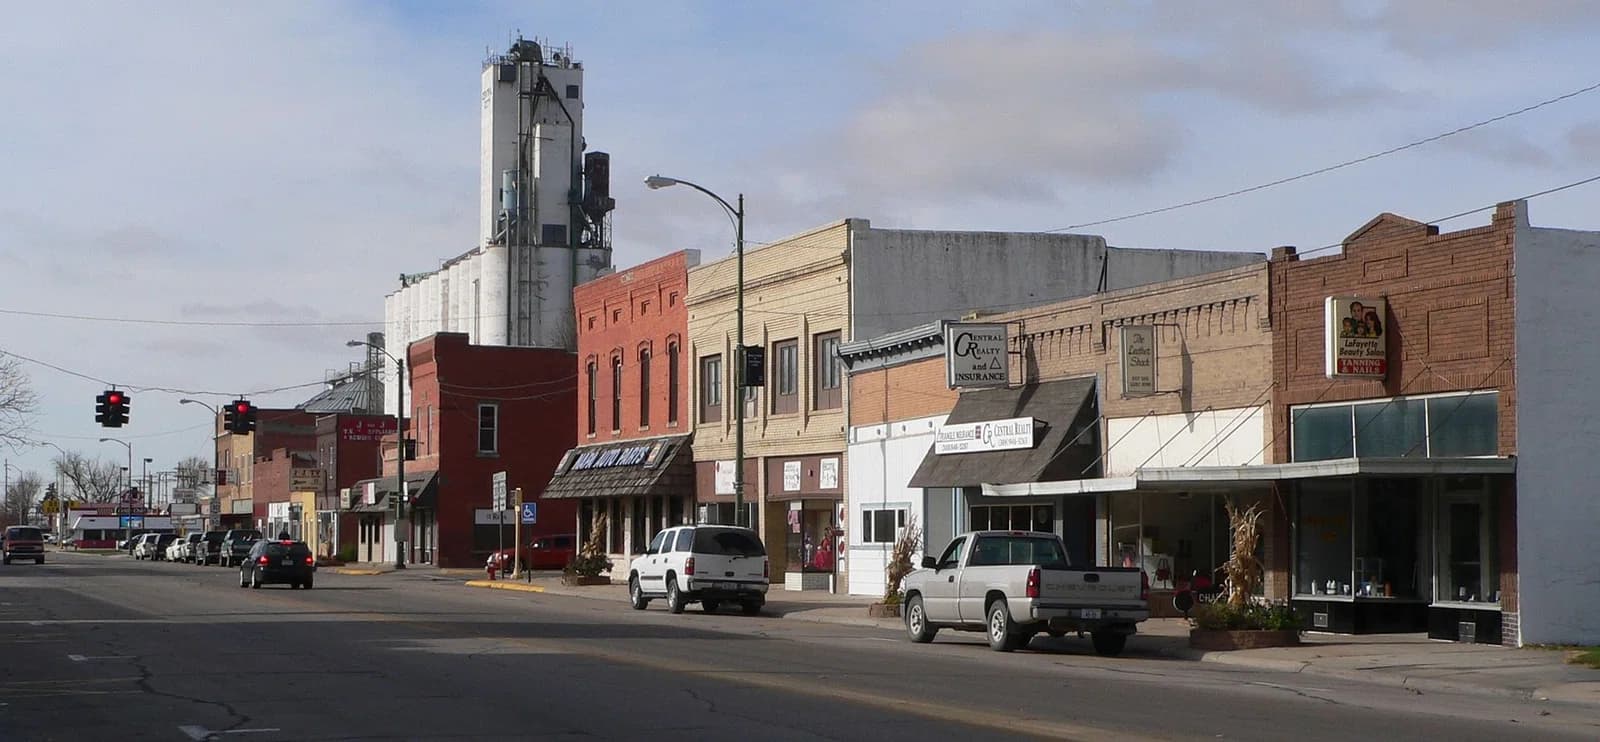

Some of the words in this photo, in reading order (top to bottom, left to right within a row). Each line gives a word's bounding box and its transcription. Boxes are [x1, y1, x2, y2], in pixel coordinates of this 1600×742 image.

[954, 332, 1004, 357] CENTRAL
[968, 342, 1001, 360] REALTY
[1339, 347, 1364, 357] Beauty
[1366, 348, 1385, 356] Salon
[972, 362, 987, 370] and
[1342, 359, 1381, 367] TANNING
[1353, 366, 1380, 374] NAILS
[954, 373, 1005, 381] INSURANCE
[592, 447, 621, 468] AUTO
[615, 445, 650, 466] PARTS
[1046, 582, 1137, 593] CHEVROLET
